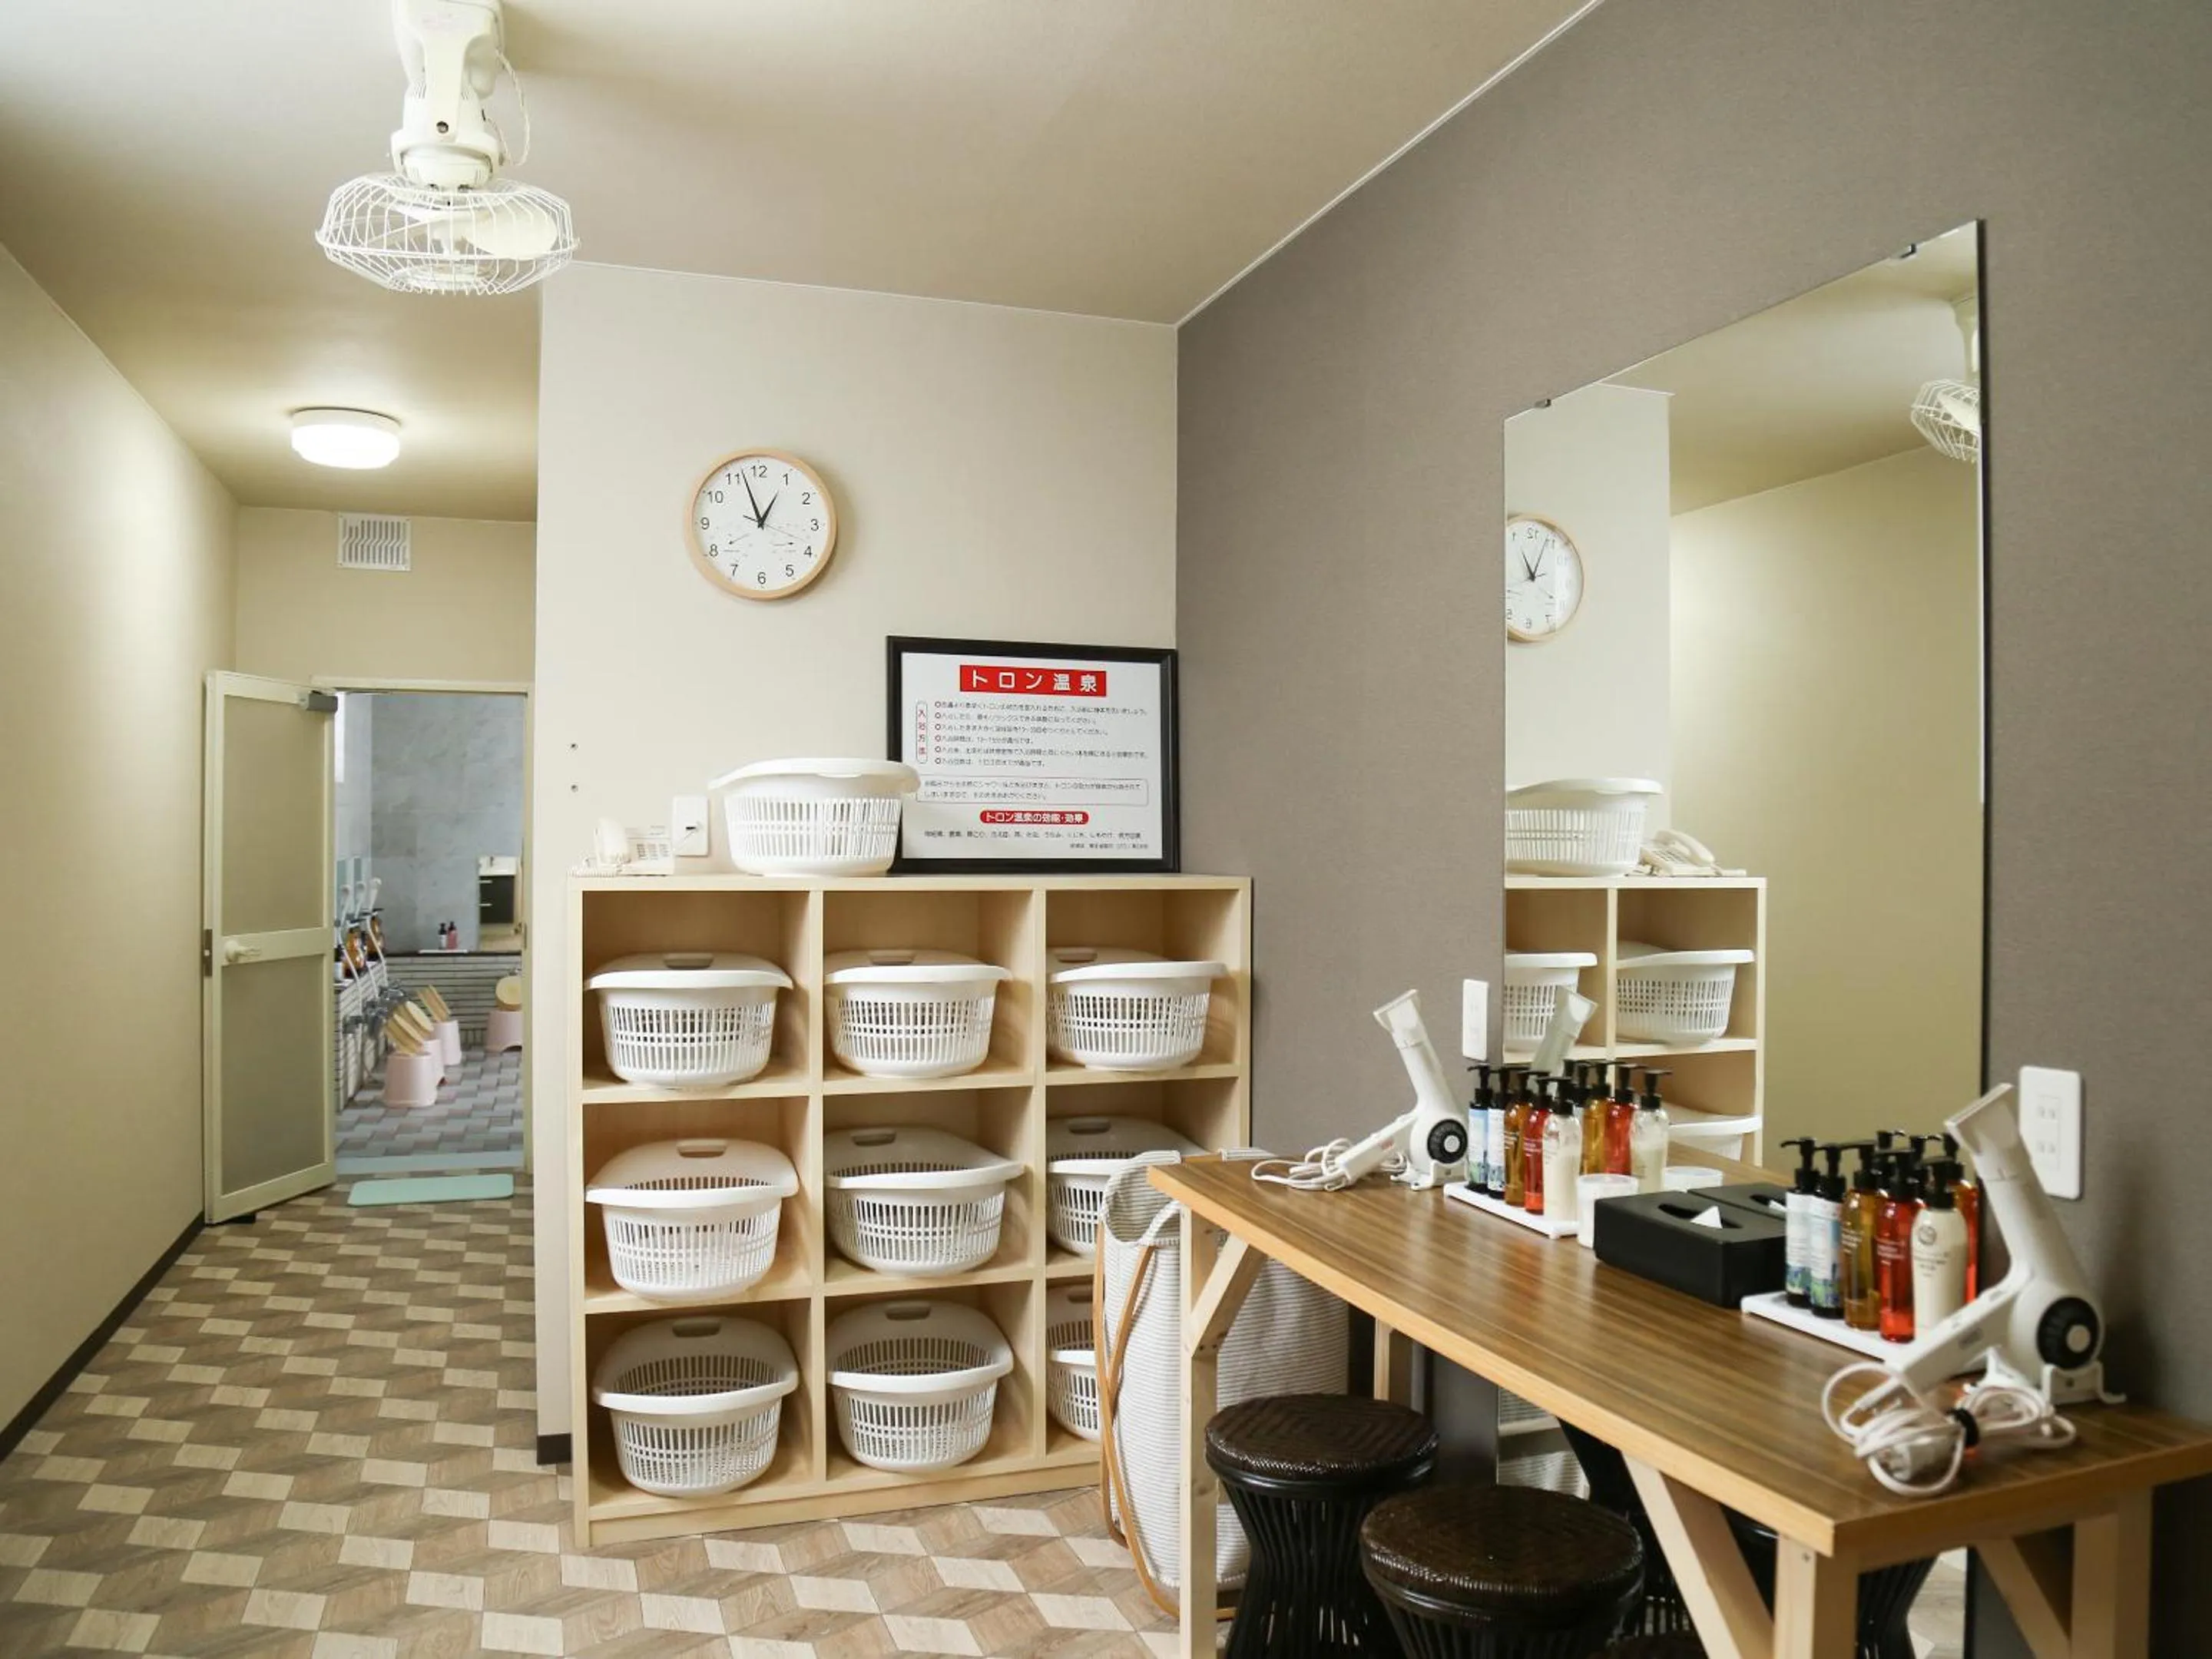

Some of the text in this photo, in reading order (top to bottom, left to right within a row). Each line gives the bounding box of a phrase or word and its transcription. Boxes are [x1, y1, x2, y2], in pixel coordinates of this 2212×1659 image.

[750, 465, 767, 478] 12
[725, 472, 741, 485] 11
[783, 473, 789, 485] 1
[707, 491, 724, 503] 10
[802, 492, 811, 505] 2
[700, 517, 710, 530] 9
[810, 518, 820, 531] 3
[709, 544, 718, 557] 8
[803, 546, 813, 558] 4
[730, 564, 738, 576] 7
[785, 565, 794, 577] 5
[757, 571, 767, 584] 6
[971, 671, 1098, 694] トロン温泉
